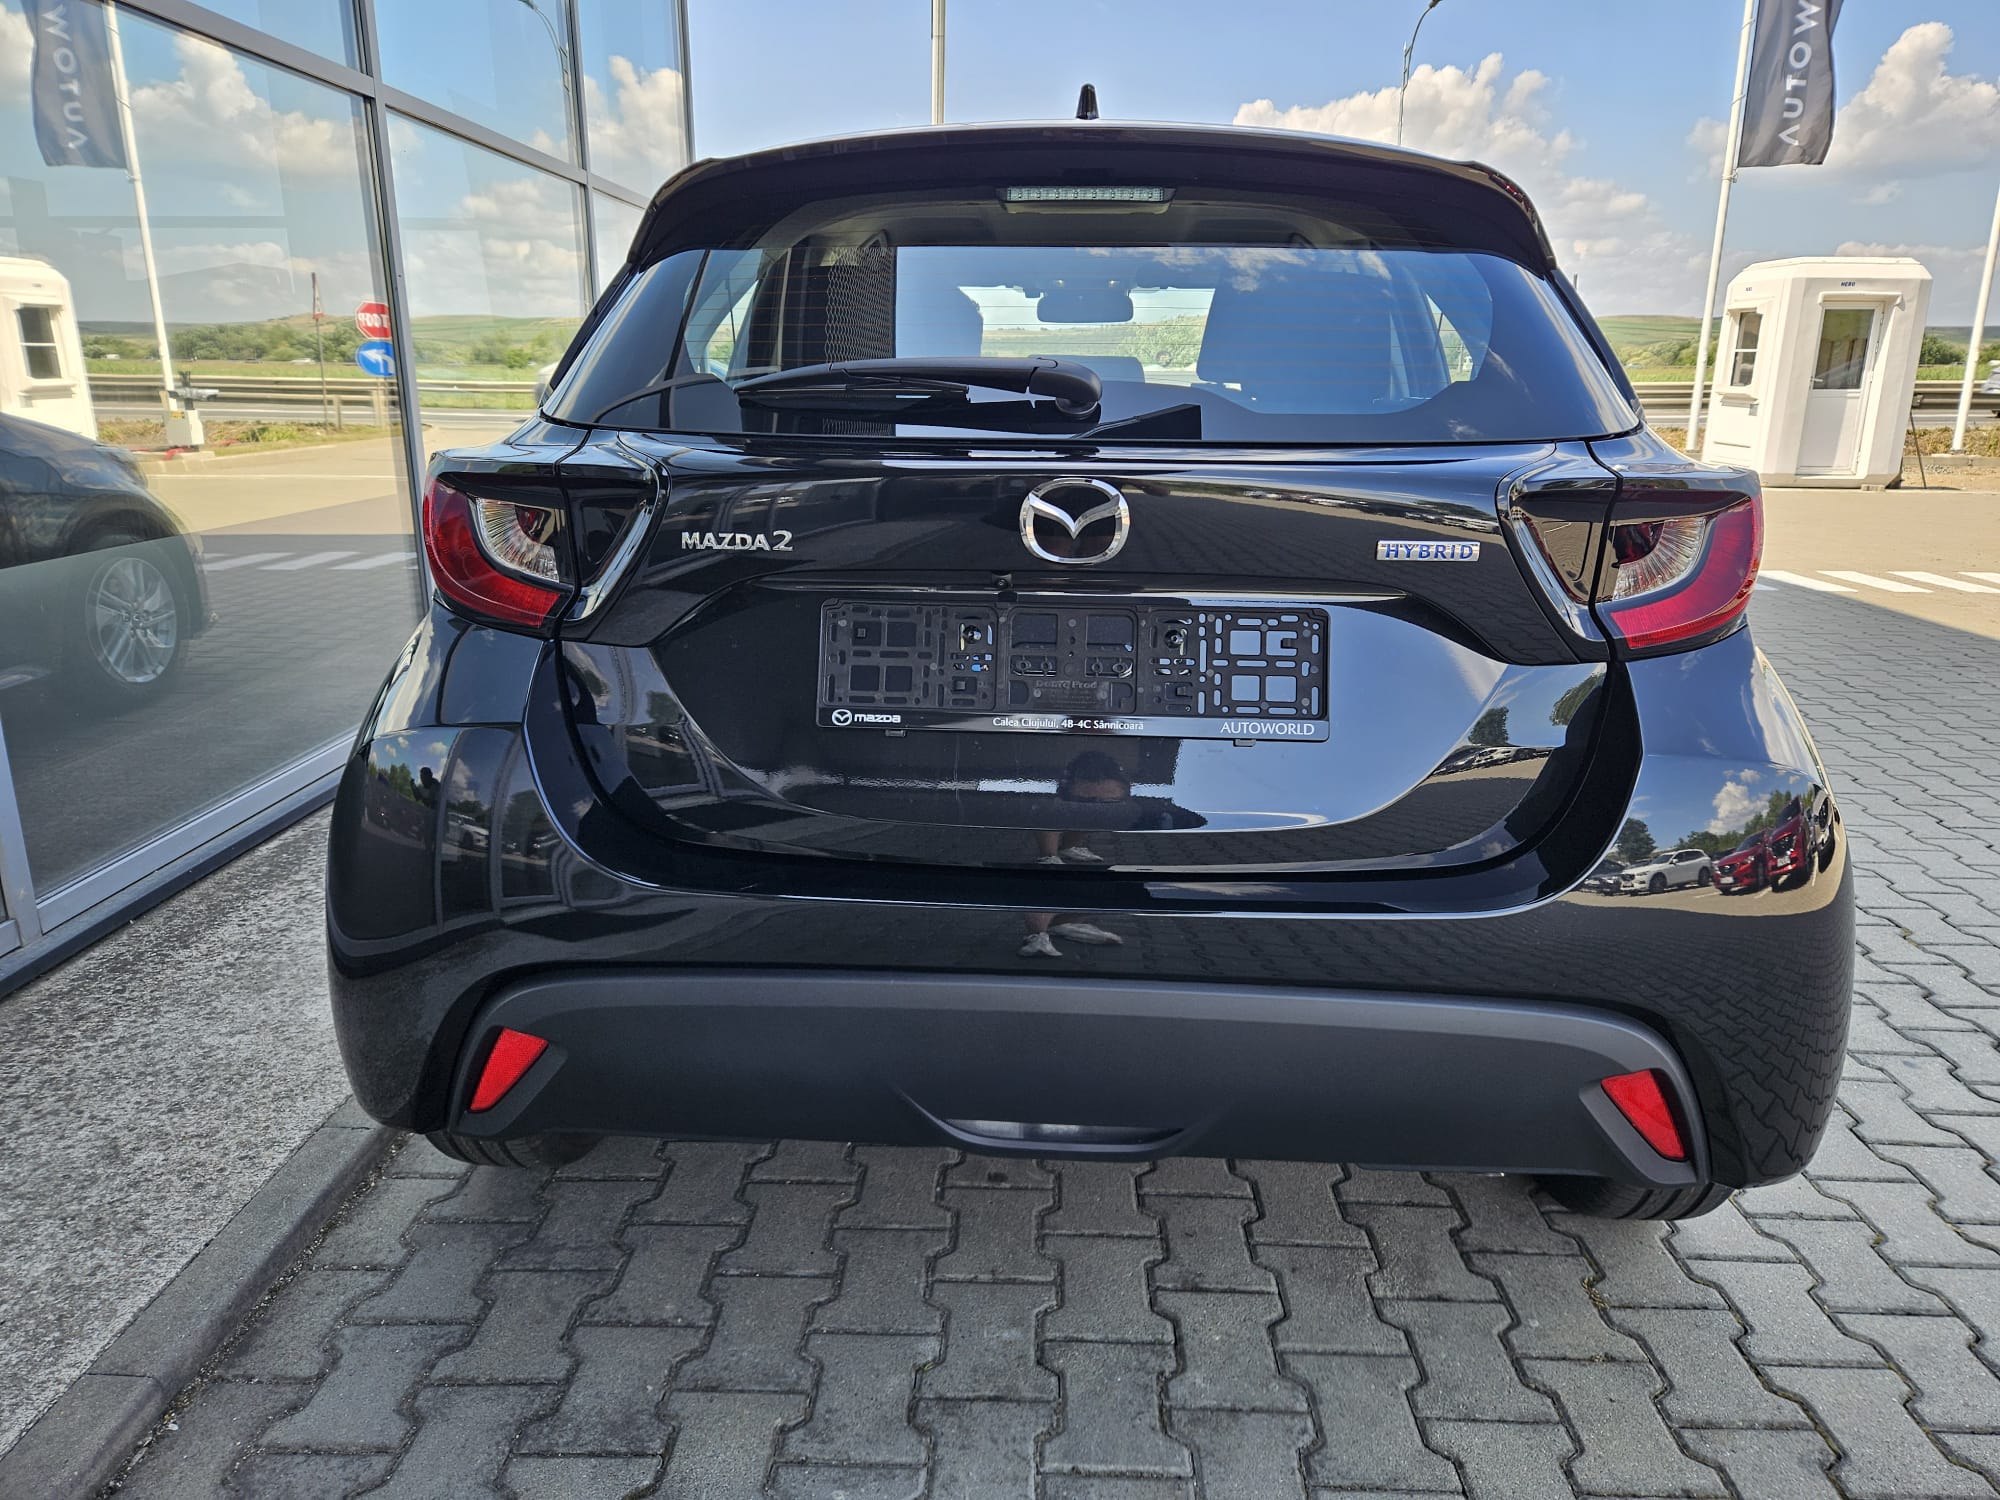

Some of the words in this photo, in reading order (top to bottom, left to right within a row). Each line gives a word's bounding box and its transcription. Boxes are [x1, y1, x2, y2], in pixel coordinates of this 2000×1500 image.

[1385, 544, 1473, 559] HYBRID
[992, 717, 1019, 728] Calea
[1061, 719, 1092, 729] 4B-4C
[1219, 721, 1315, 736] AUTOWORLD
